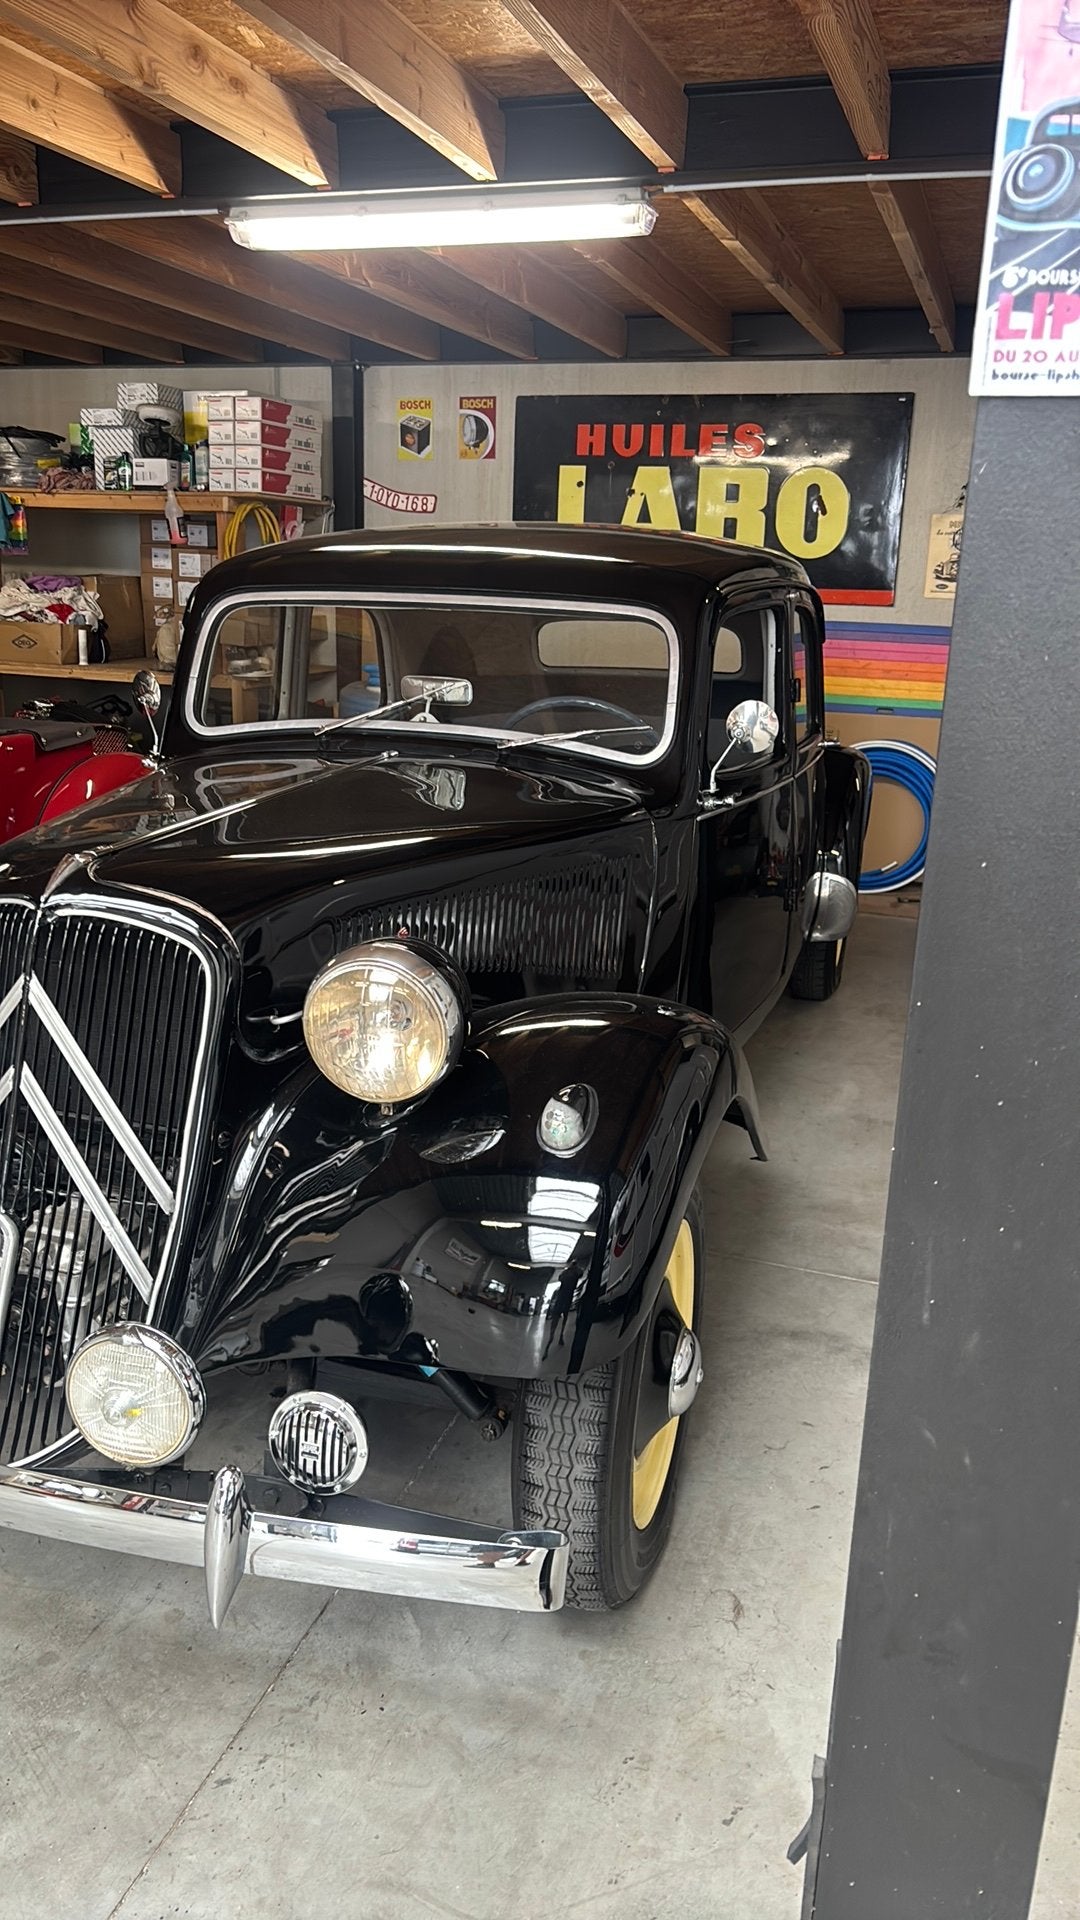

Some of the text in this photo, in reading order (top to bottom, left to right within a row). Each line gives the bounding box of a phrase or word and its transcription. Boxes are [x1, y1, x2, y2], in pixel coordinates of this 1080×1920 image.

[1028, 268, 1080, 286] BOURS
[993, 349, 1080, 363] DU 20 AU
[400, 400, 431, 410] BOSCH
[462, 398, 494, 409] BOSCH
[576, 423, 766, 459] HUILES
